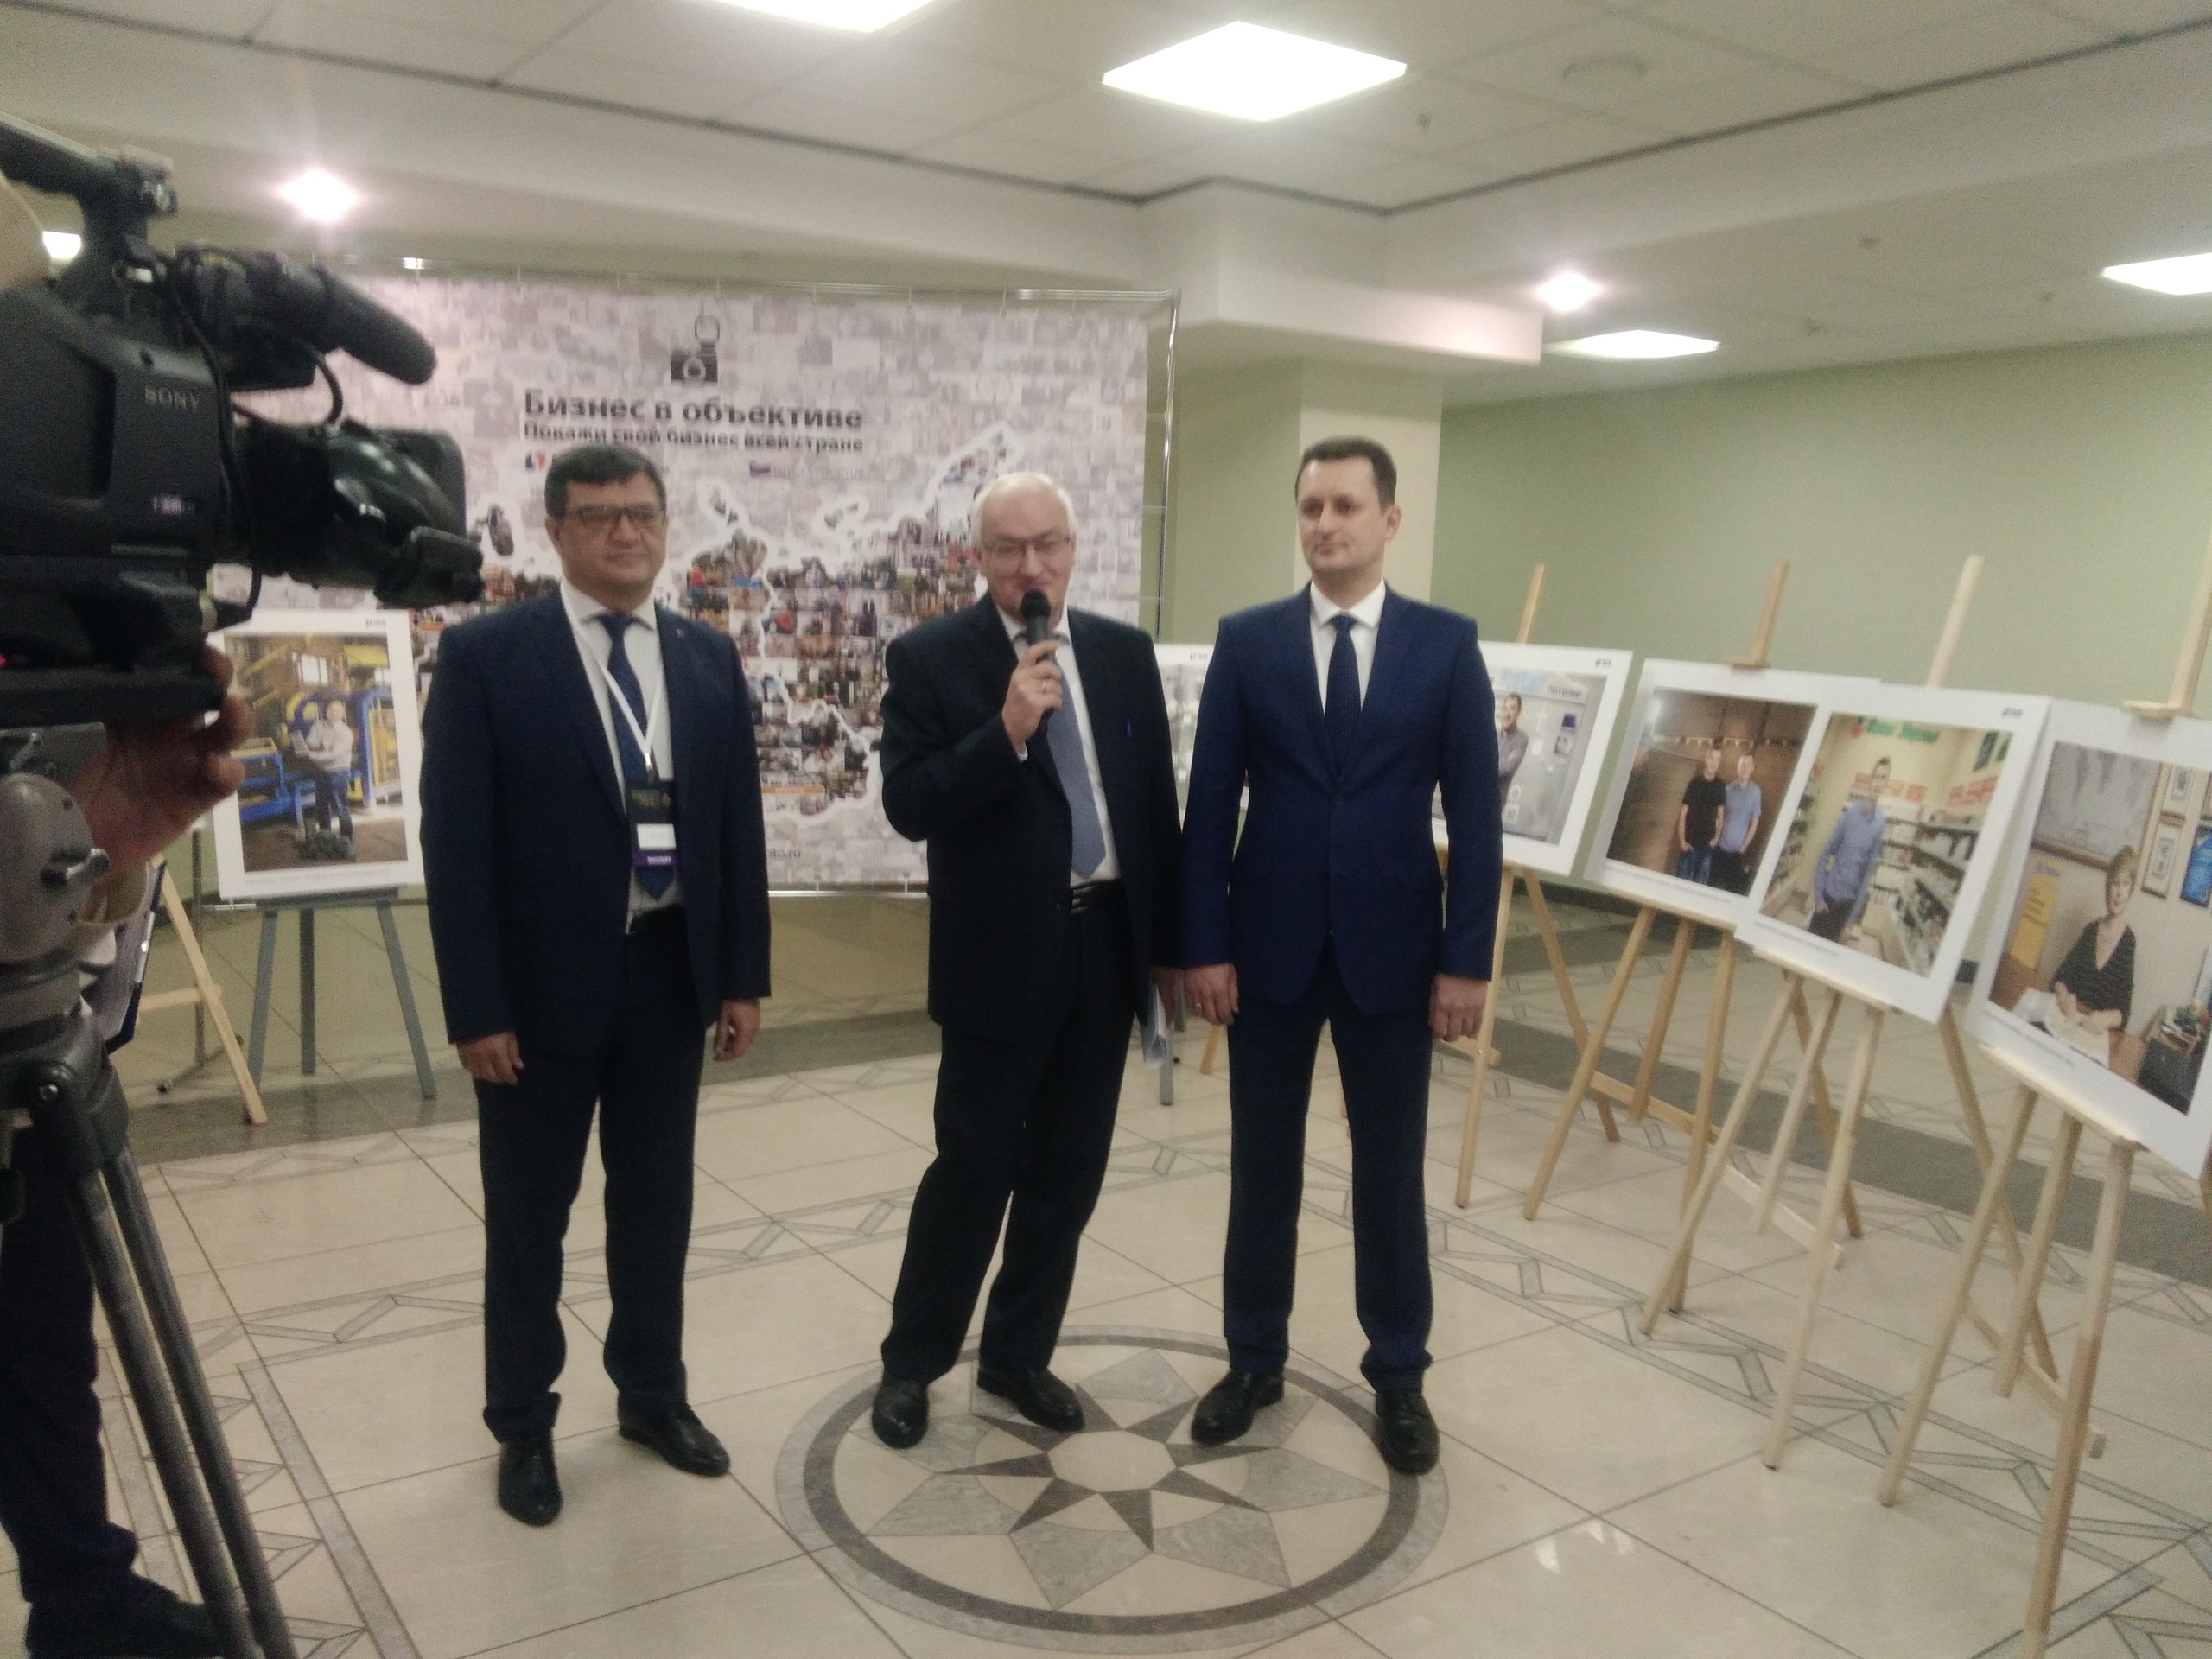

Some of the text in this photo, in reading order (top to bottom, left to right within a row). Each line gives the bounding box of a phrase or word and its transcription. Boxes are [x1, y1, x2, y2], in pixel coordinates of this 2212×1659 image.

[144, 384, 200, 410] SONY
[524, 388, 863, 429] Бизнес в объективе
[524, 422, 863, 454] Покажи свой бизнес всей стране
